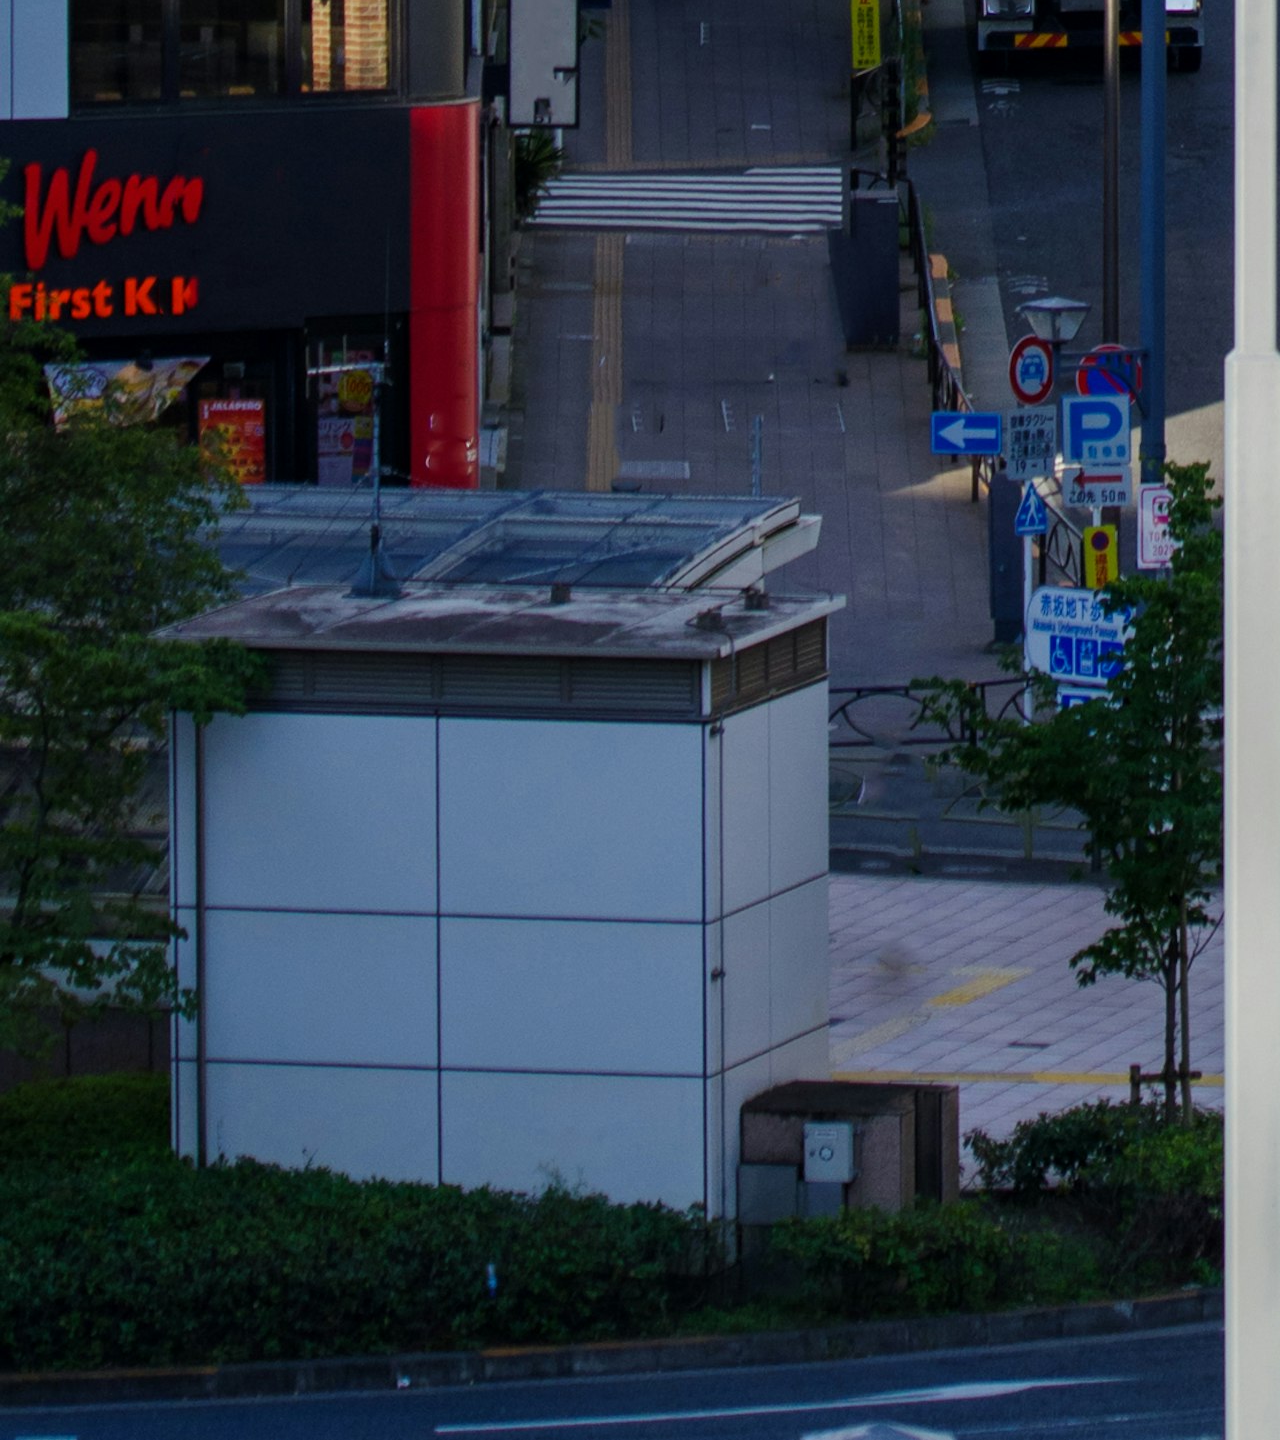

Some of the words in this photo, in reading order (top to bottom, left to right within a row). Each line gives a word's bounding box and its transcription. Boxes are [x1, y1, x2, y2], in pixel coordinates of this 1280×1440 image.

[9, 279, 113, 321] First
[1069, 401, 1123, 459] P
[1101, 489, 1127, 504] 50m
